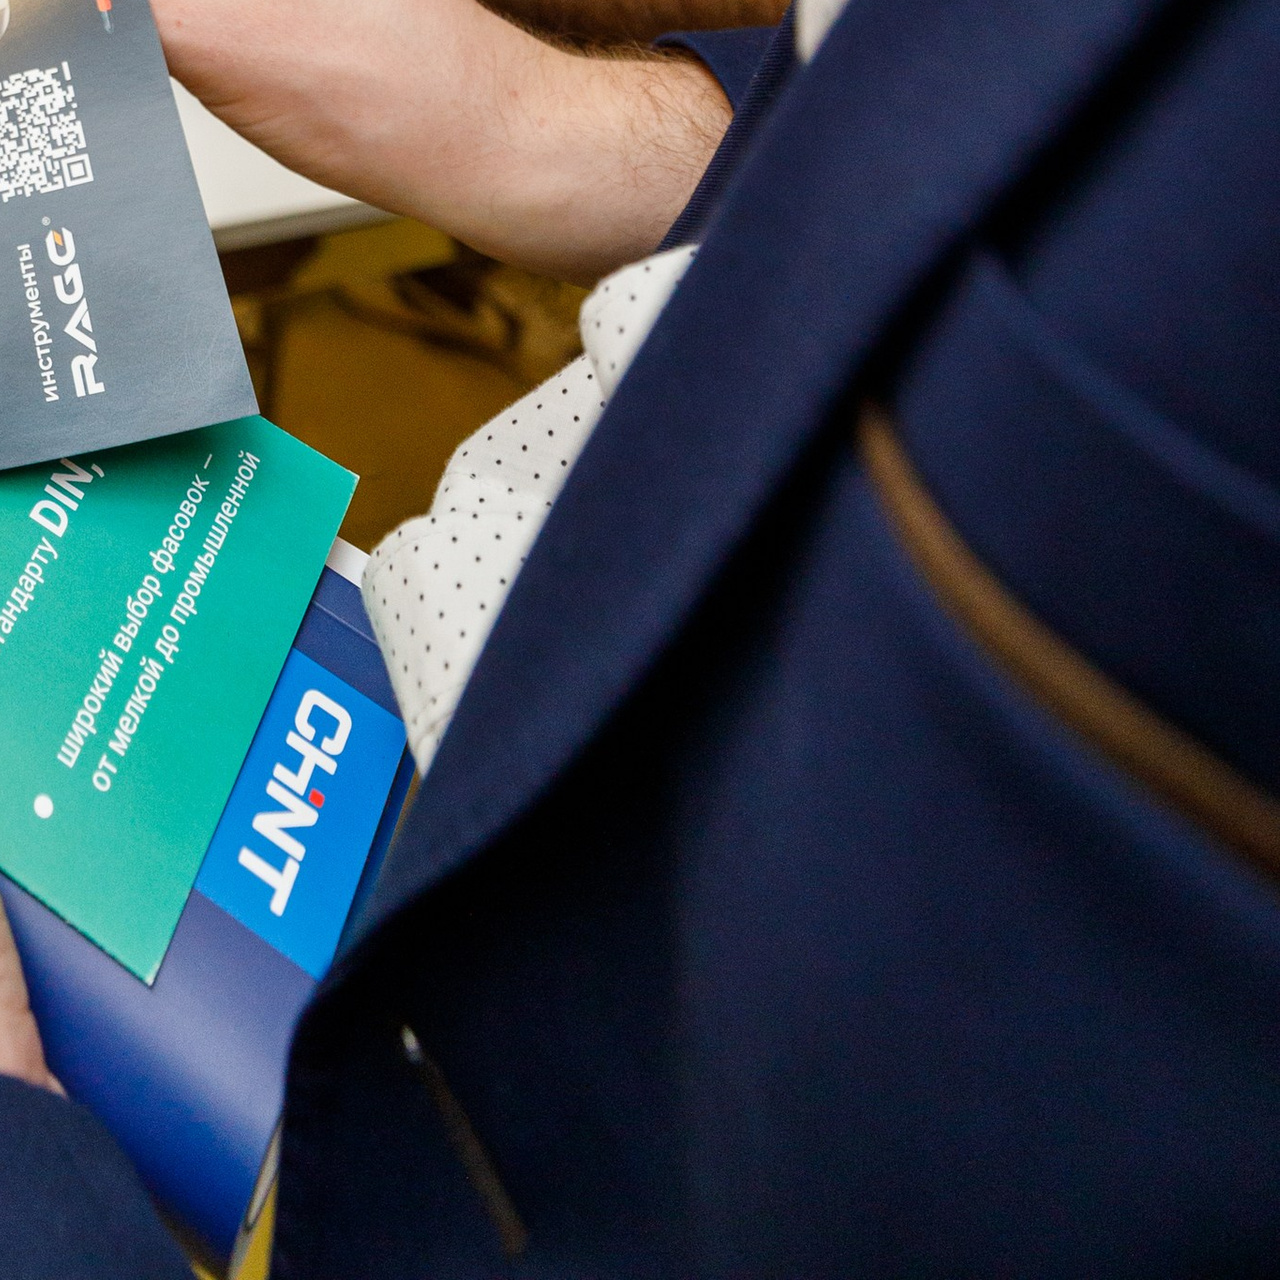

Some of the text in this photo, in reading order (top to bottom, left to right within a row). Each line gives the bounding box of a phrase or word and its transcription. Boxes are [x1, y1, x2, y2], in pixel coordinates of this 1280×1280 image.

[17, 243, 60, 403] инструменты
[56, 648, 124, 769] широкий
[112, 573, 164, 653] выбор
[148, 473, 210, 574] фасовок
[91, 450, 261, 792] от мелкой до промышленной
